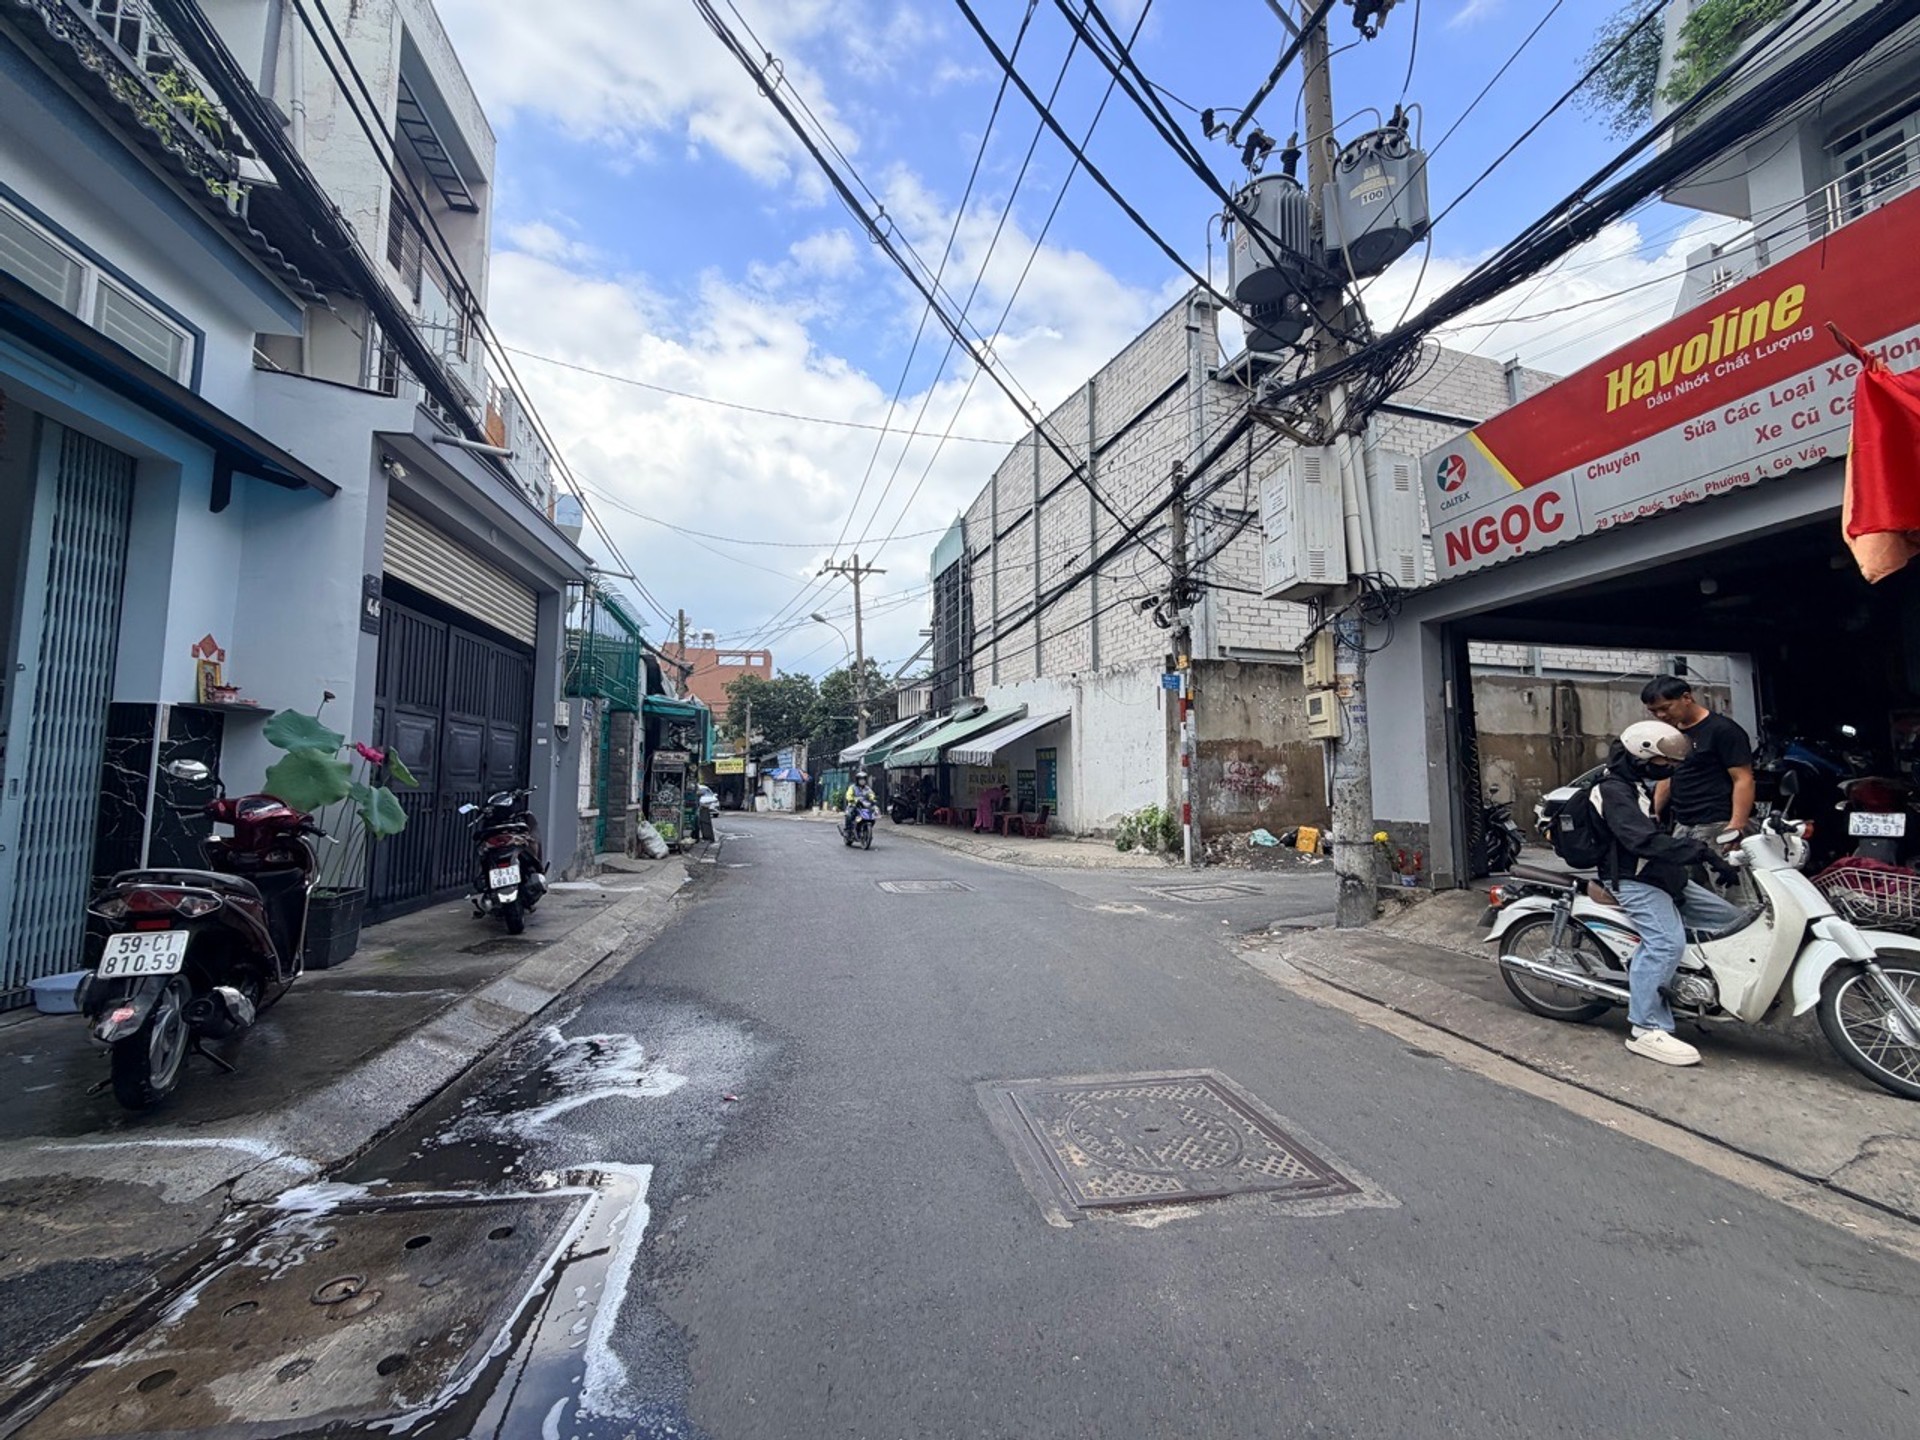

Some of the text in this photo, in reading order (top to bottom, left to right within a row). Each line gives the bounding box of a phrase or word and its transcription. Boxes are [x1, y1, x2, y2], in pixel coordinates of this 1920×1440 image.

[1362, 190, 1383, 203] 100
[1605, 283, 1806, 413] Havoline
[1674, 372, 1710, 397] Nhớt
[1714, 351, 1751, 378] Chất
[1756, 325, 1814, 360] Lượng
[1683, 417, 1717, 442] Sửa
[1723, 398, 1761, 425] Các
[1769, 376, 1815, 408] Loại
[1826, 361, 1858, 386] Xe
[1755, 423, 1783, 444] Xe
[1790, 406, 1820, 430] Cũ
[1586, 449, 1641, 480] Chuyên
[1440, 491, 1471, 512] CALTEX
[1596, 517, 1608, 530] 29
[1668, 486, 1699, 506] Tuấn,
[1704, 470, 1751, 494] Phường
[1755, 465, 1767, 477] 1,
[1773, 454, 1793, 471] Gò
[1798, 443, 1828, 463] Vấp
[1444, 490, 1565, 567] NGỌC
[366, 597, 381, 618] 46
[118, 935, 174, 955] 59-C1
[104, 952, 178, 975] 810.59
